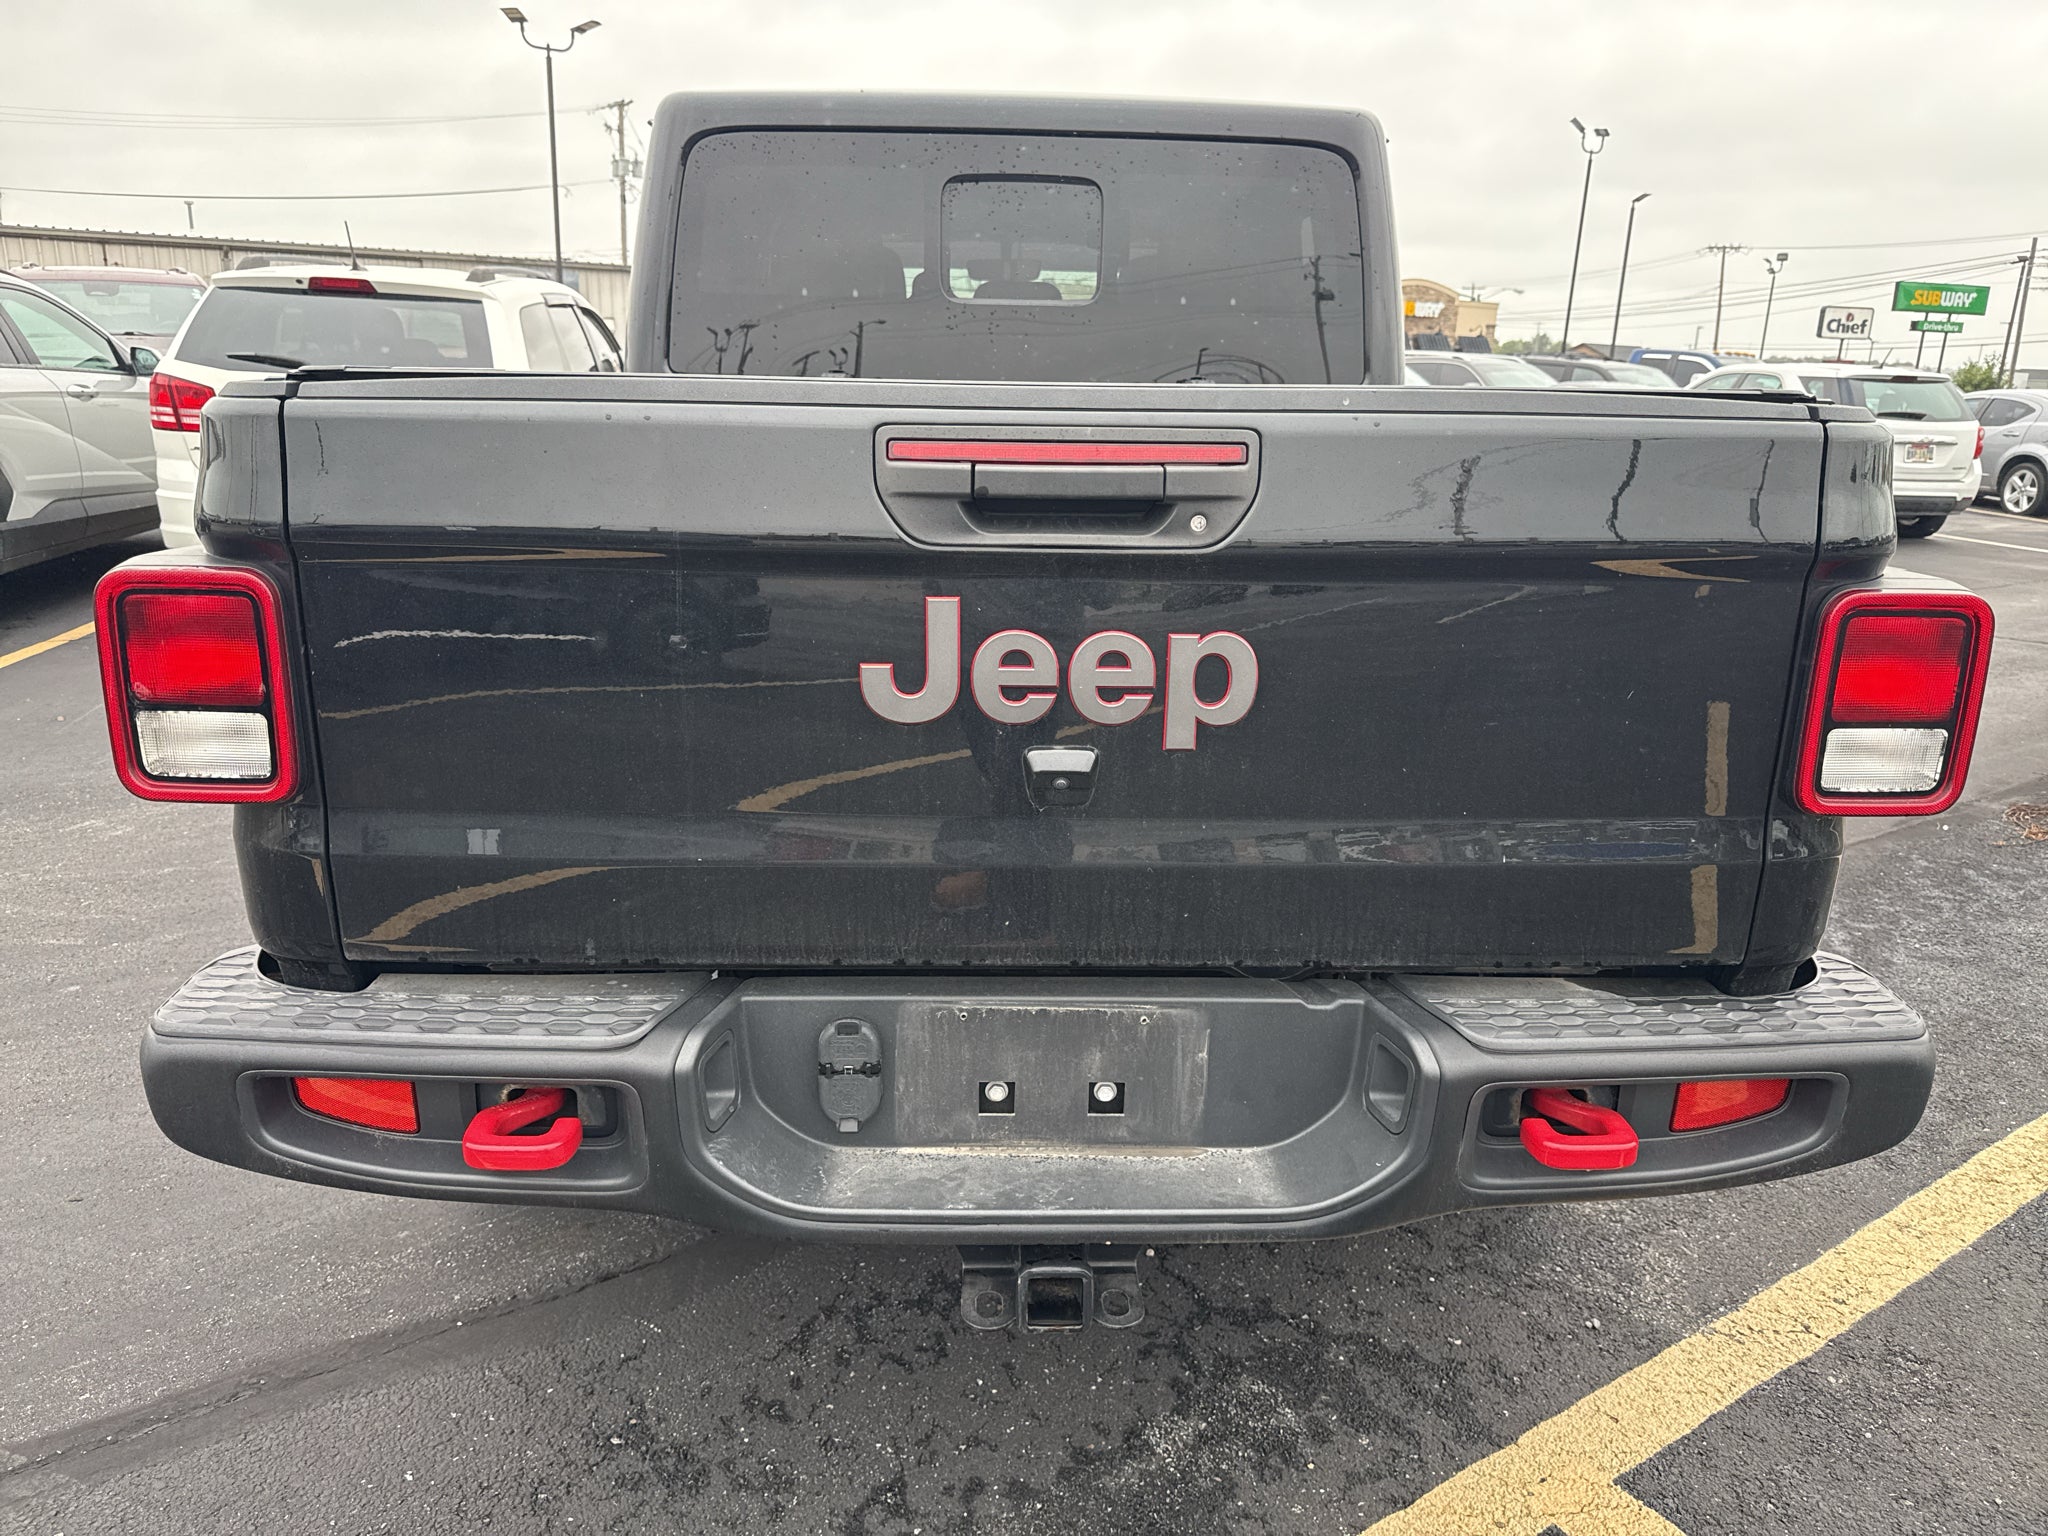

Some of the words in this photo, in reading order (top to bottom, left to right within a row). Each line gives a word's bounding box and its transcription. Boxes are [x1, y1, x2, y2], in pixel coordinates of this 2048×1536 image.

[1910, 289, 1978, 308] SUBWAY
[1826, 313, 1869, 334] Chief
[859, 596, 1259, 750] Jeep
